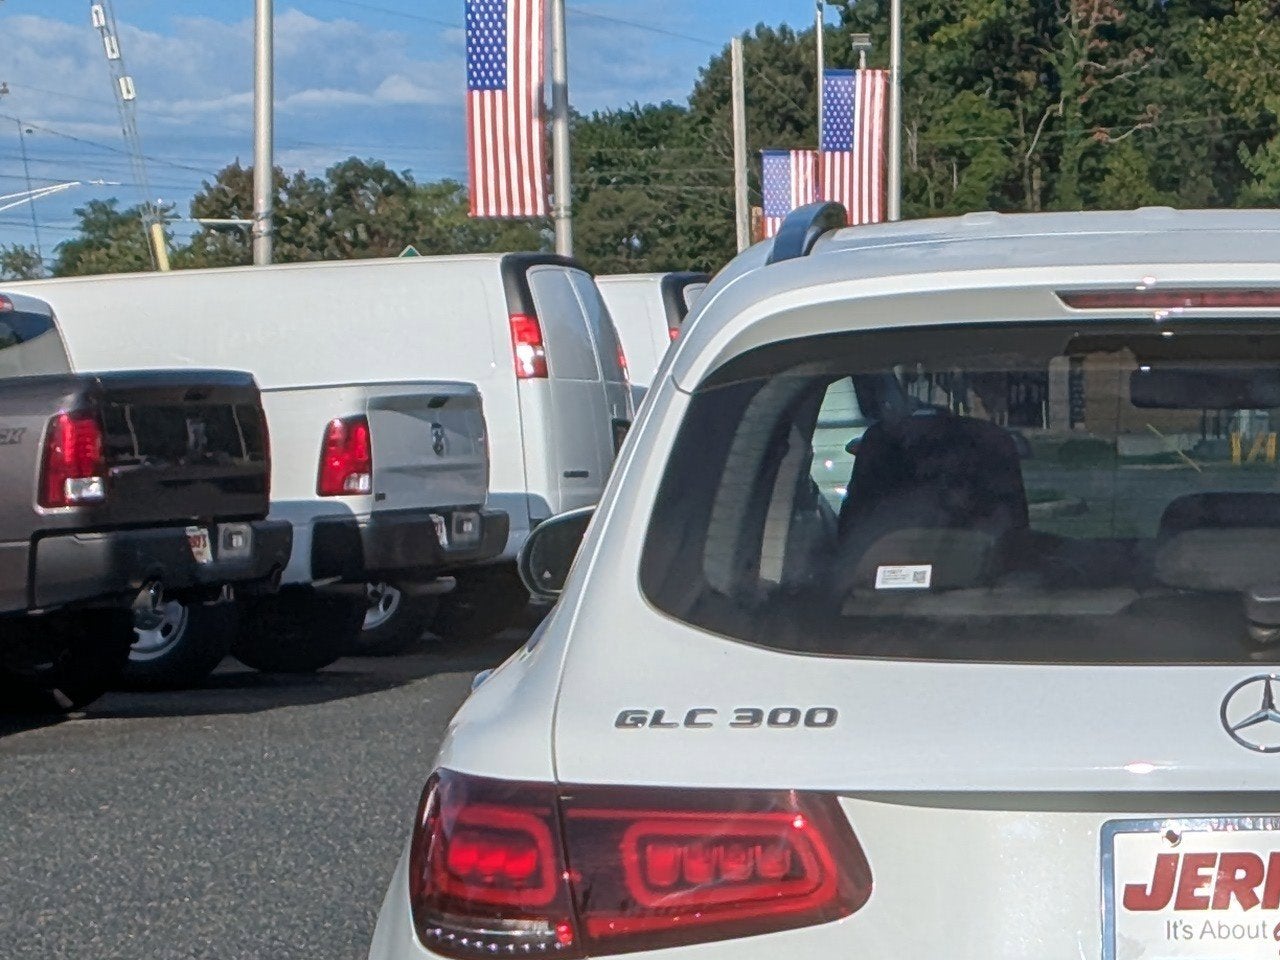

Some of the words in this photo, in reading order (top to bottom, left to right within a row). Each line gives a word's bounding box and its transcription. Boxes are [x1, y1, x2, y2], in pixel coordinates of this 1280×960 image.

[614, 707, 718, 728] GLC
[729, 707, 839, 728] 300
[1165, 920, 1194, 941] It's
[1199, 919, 1268, 941] About
